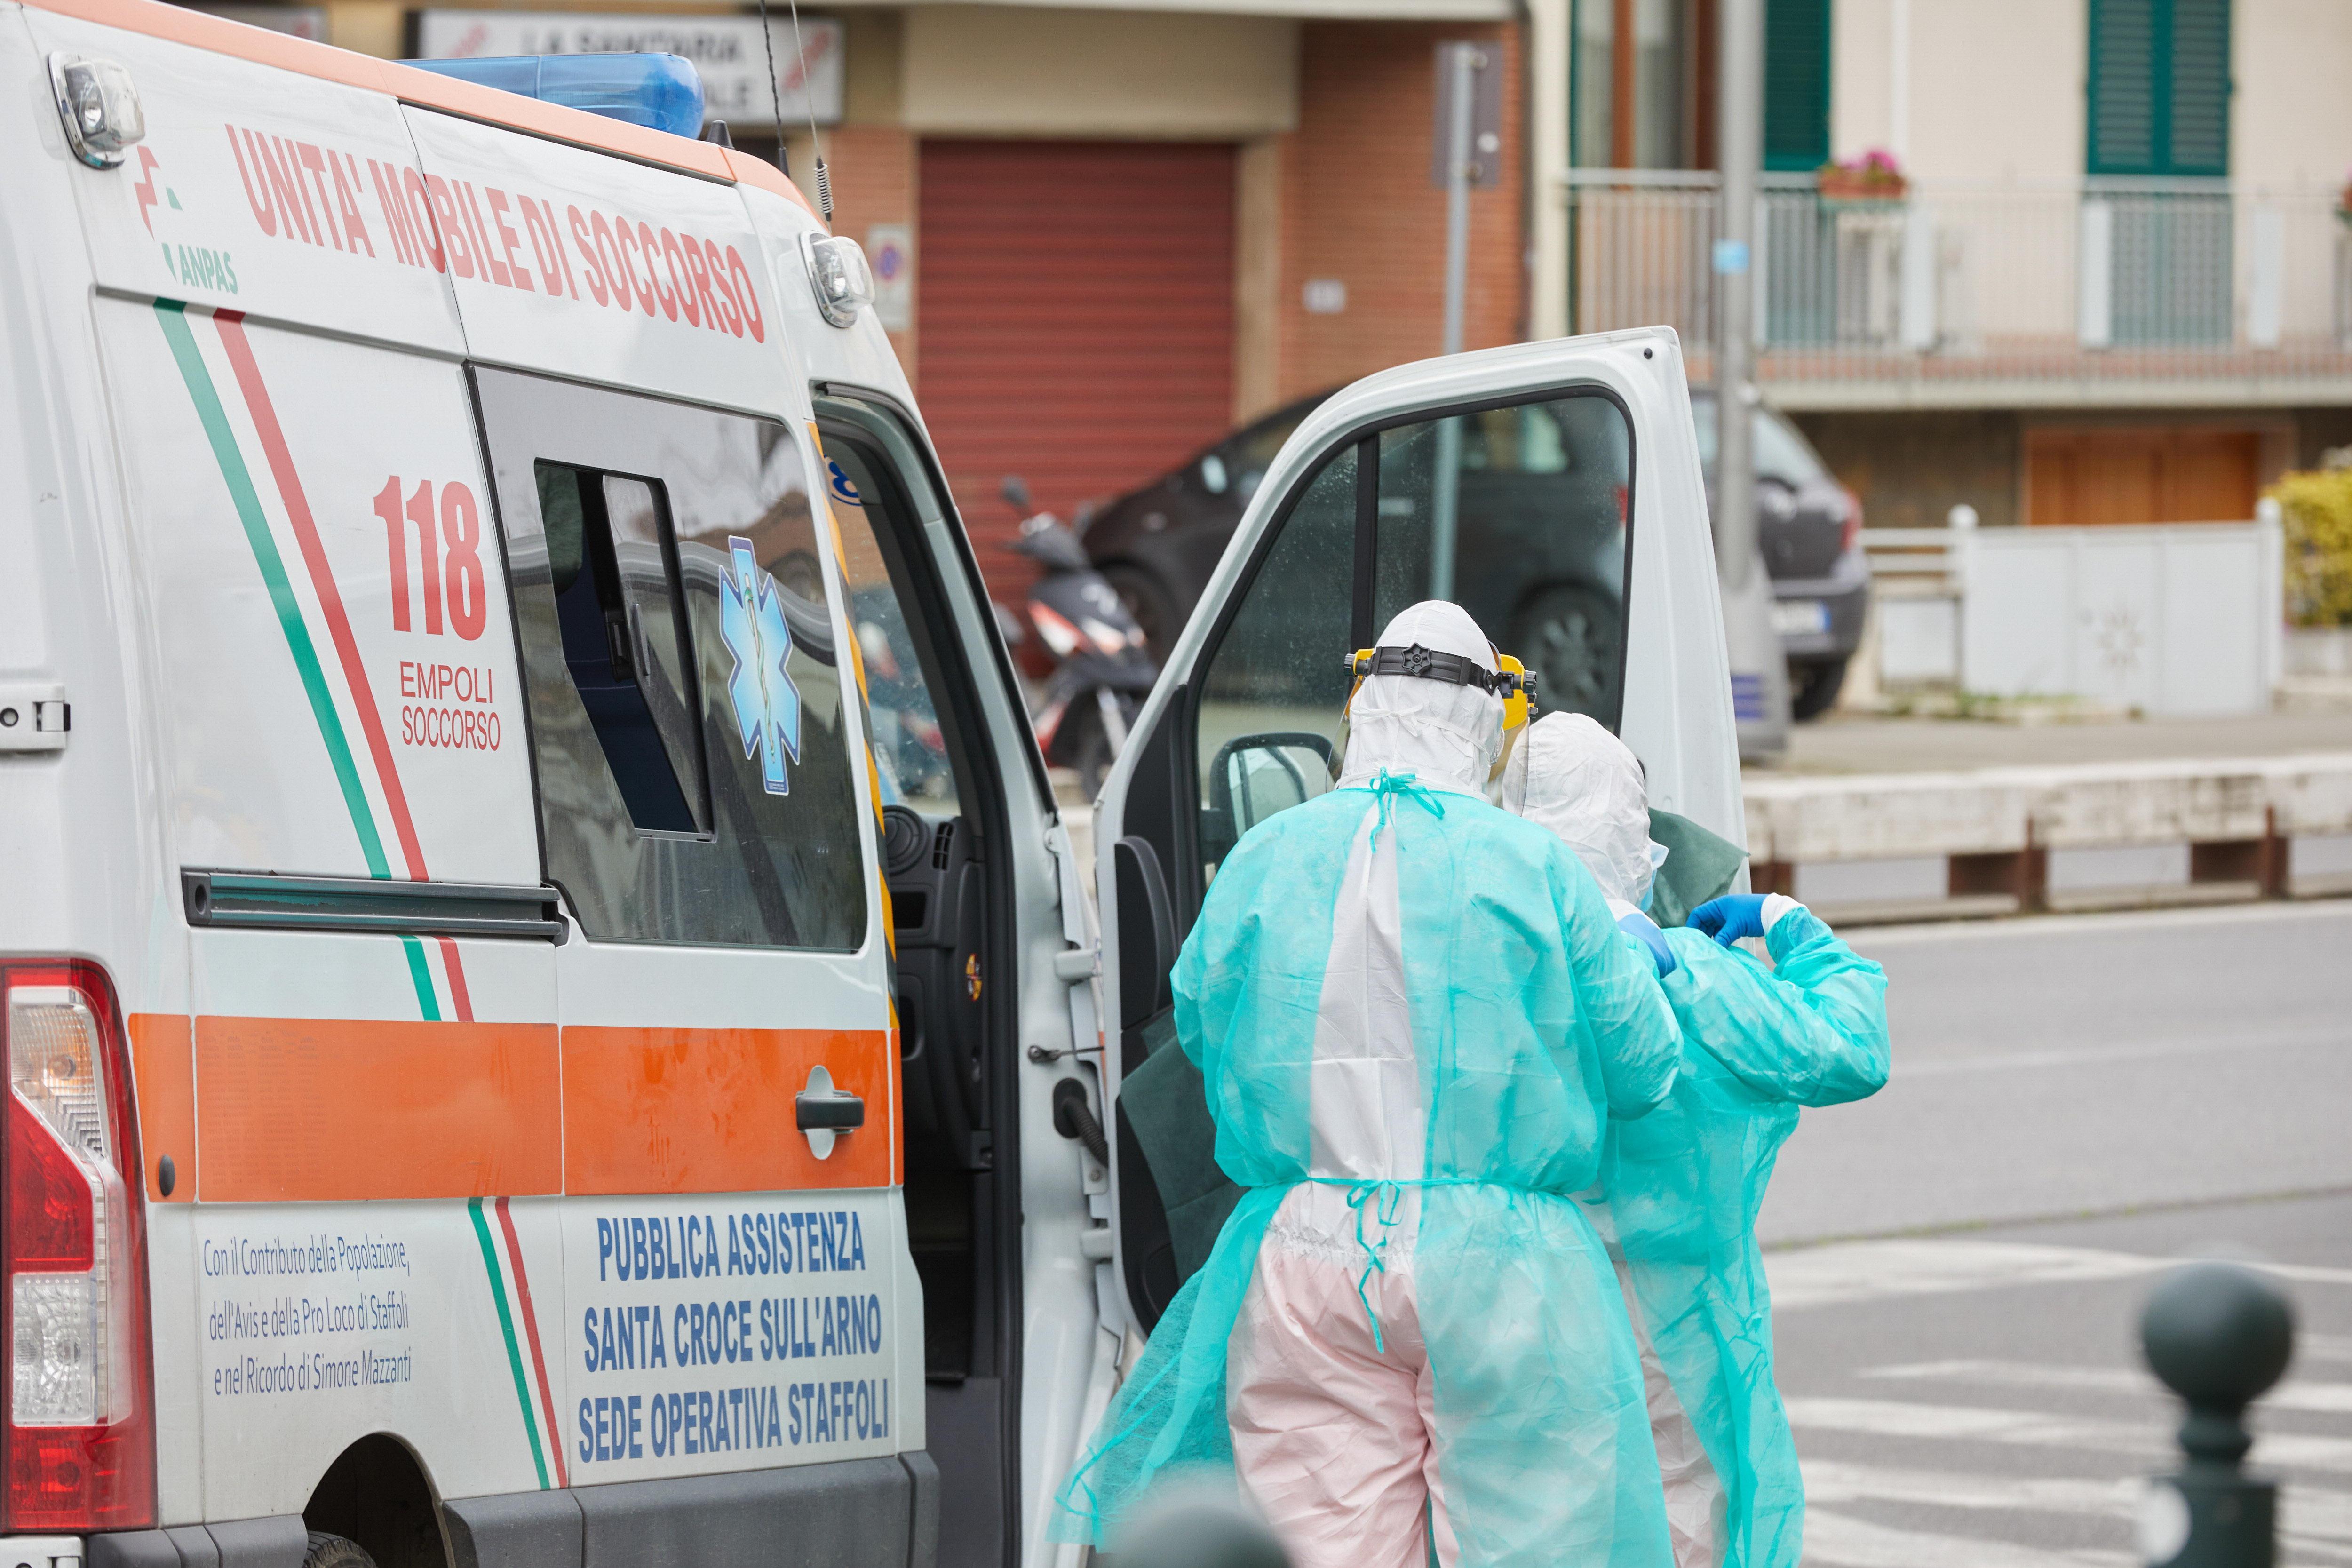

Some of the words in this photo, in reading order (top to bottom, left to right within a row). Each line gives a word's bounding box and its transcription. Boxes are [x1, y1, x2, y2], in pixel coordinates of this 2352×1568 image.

[225, 124, 376, 258] UNITA'
[367, 158, 535, 292] MOBILE
[517, 195, 580, 300] DI
[567, 204, 766, 344] SOCCORSO
[178, 245, 238, 294] ANPAS
[373, 475, 487, 642] 118
[399, 661, 493, 704] EMPOLI
[401, 705, 501, 751] SOCCORSO
[204, 1239, 229, 1277] Con
[230, 1236, 238, 1276] il
[241, 1235, 306, 1276] Contributo
[308, 1234, 337, 1274] della
[338, 1232, 410, 1282] Popolazione,
[596, 1215, 721, 1282] PUBBLICA
[727, 1211, 866, 1276] ASSISTENZA
[209, 1300, 258, 1341] dell'Avis
[261, 1311, 269, 1337] e
[272, 1297, 300, 1337] della
[302, 1298, 324, 1334] Pro
[326, 1297, 355, 1333] Loco
[358, 1292, 369, 1331] di
[371, 1290, 409, 1330] Staffoli
[584, 1305, 667, 1372] SANTA
[674, 1300, 753, 1367] CROCE
[759, 1294, 882, 1361] SULL'ARNO
[215, 1368, 222, 1396] e
[225, 1355, 243, 1395] nel
[247, 1353, 294, 1394] Ricordo
[298, 1352, 310, 1391] di
[313, 1353, 358, 1391] Simone
[361, 1346, 412, 1385] Mazzanti
[579, 1395, 643, 1463] SEDE
[651, 1385, 782, 1458] OPERATIVA
[788, 1378, 889, 1445] STAFFOLI
